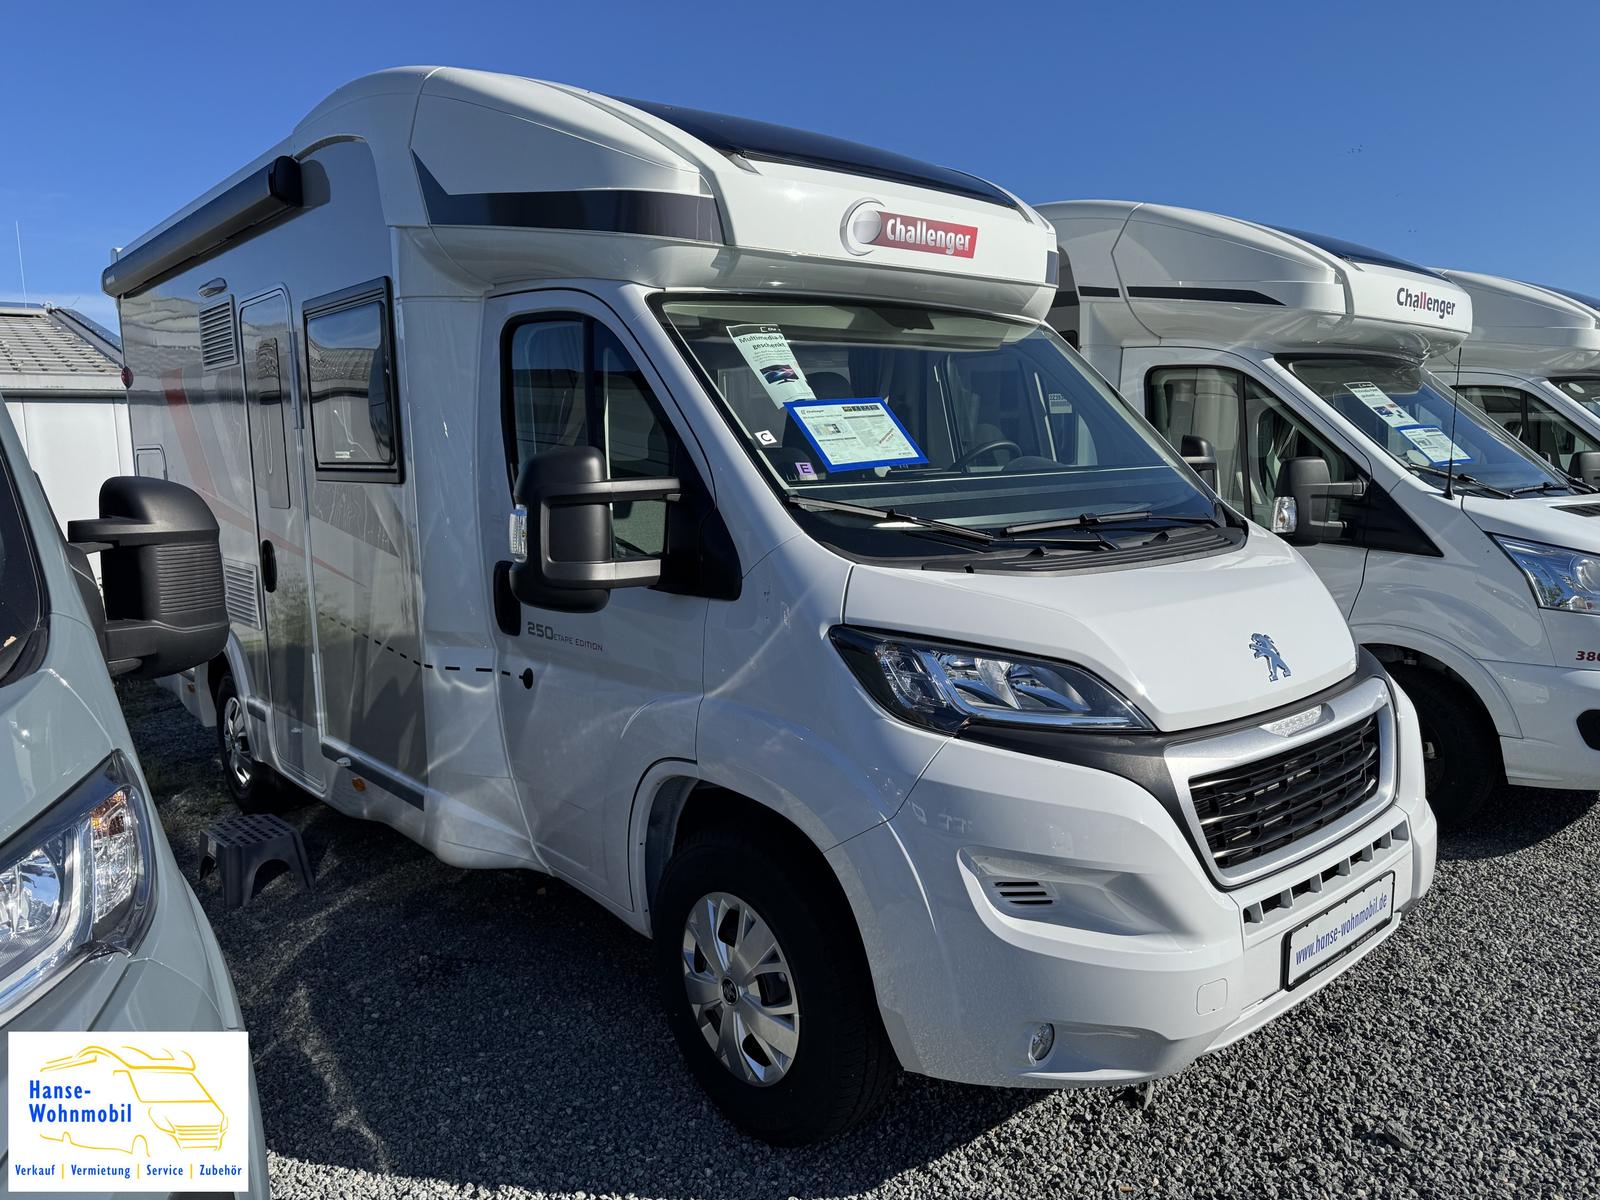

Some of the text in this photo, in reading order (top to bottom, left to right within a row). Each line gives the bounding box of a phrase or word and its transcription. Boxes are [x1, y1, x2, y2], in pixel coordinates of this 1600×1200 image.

[886, 217, 971, 255] Challenger
[1396, 287, 1456, 320] Challenger
[752, 342, 786, 350] geschenkt
[760, 432, 772, 442] C
[800, 464, 812, 474] E
[527, 621, 604, 652] 250 ETAPE EDITION
[1295, 891, 1388, 966] www.hanse-wohnmobil.de
